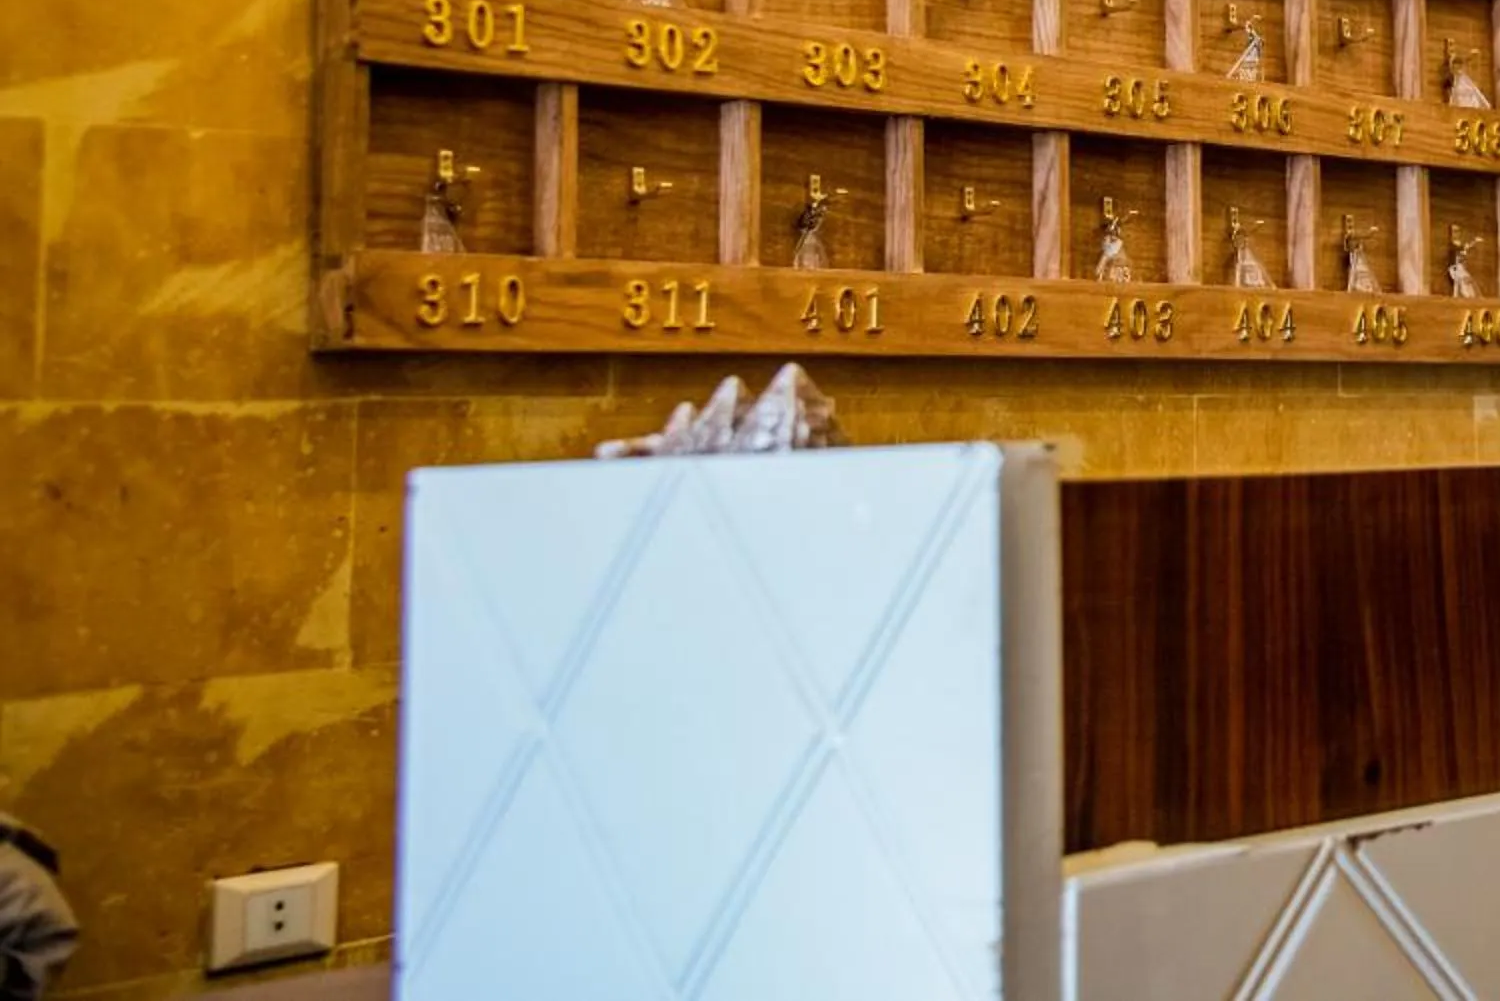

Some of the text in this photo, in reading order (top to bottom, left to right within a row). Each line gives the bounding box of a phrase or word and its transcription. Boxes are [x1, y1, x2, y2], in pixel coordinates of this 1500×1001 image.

[625, 19, 719, 74] 302
[803, 42, 886, 91] 303
[961, 55, 1035, 108] 304
[1103, 75, 1171, 121] 305
[1231, 93, 1292, 136] 306
[1348, 104, 1405, 148] 307
[417, 272, 527, 328] 310
[623, 278, 716, 330] 311
[800, 285, 885, 334] 401
[963, 294, 1039, 339] 402
[1103, 298, 1173, 341] 403
[1233, 301, 1297, 343] 404
[1352, 304, 1408, 345] 405
